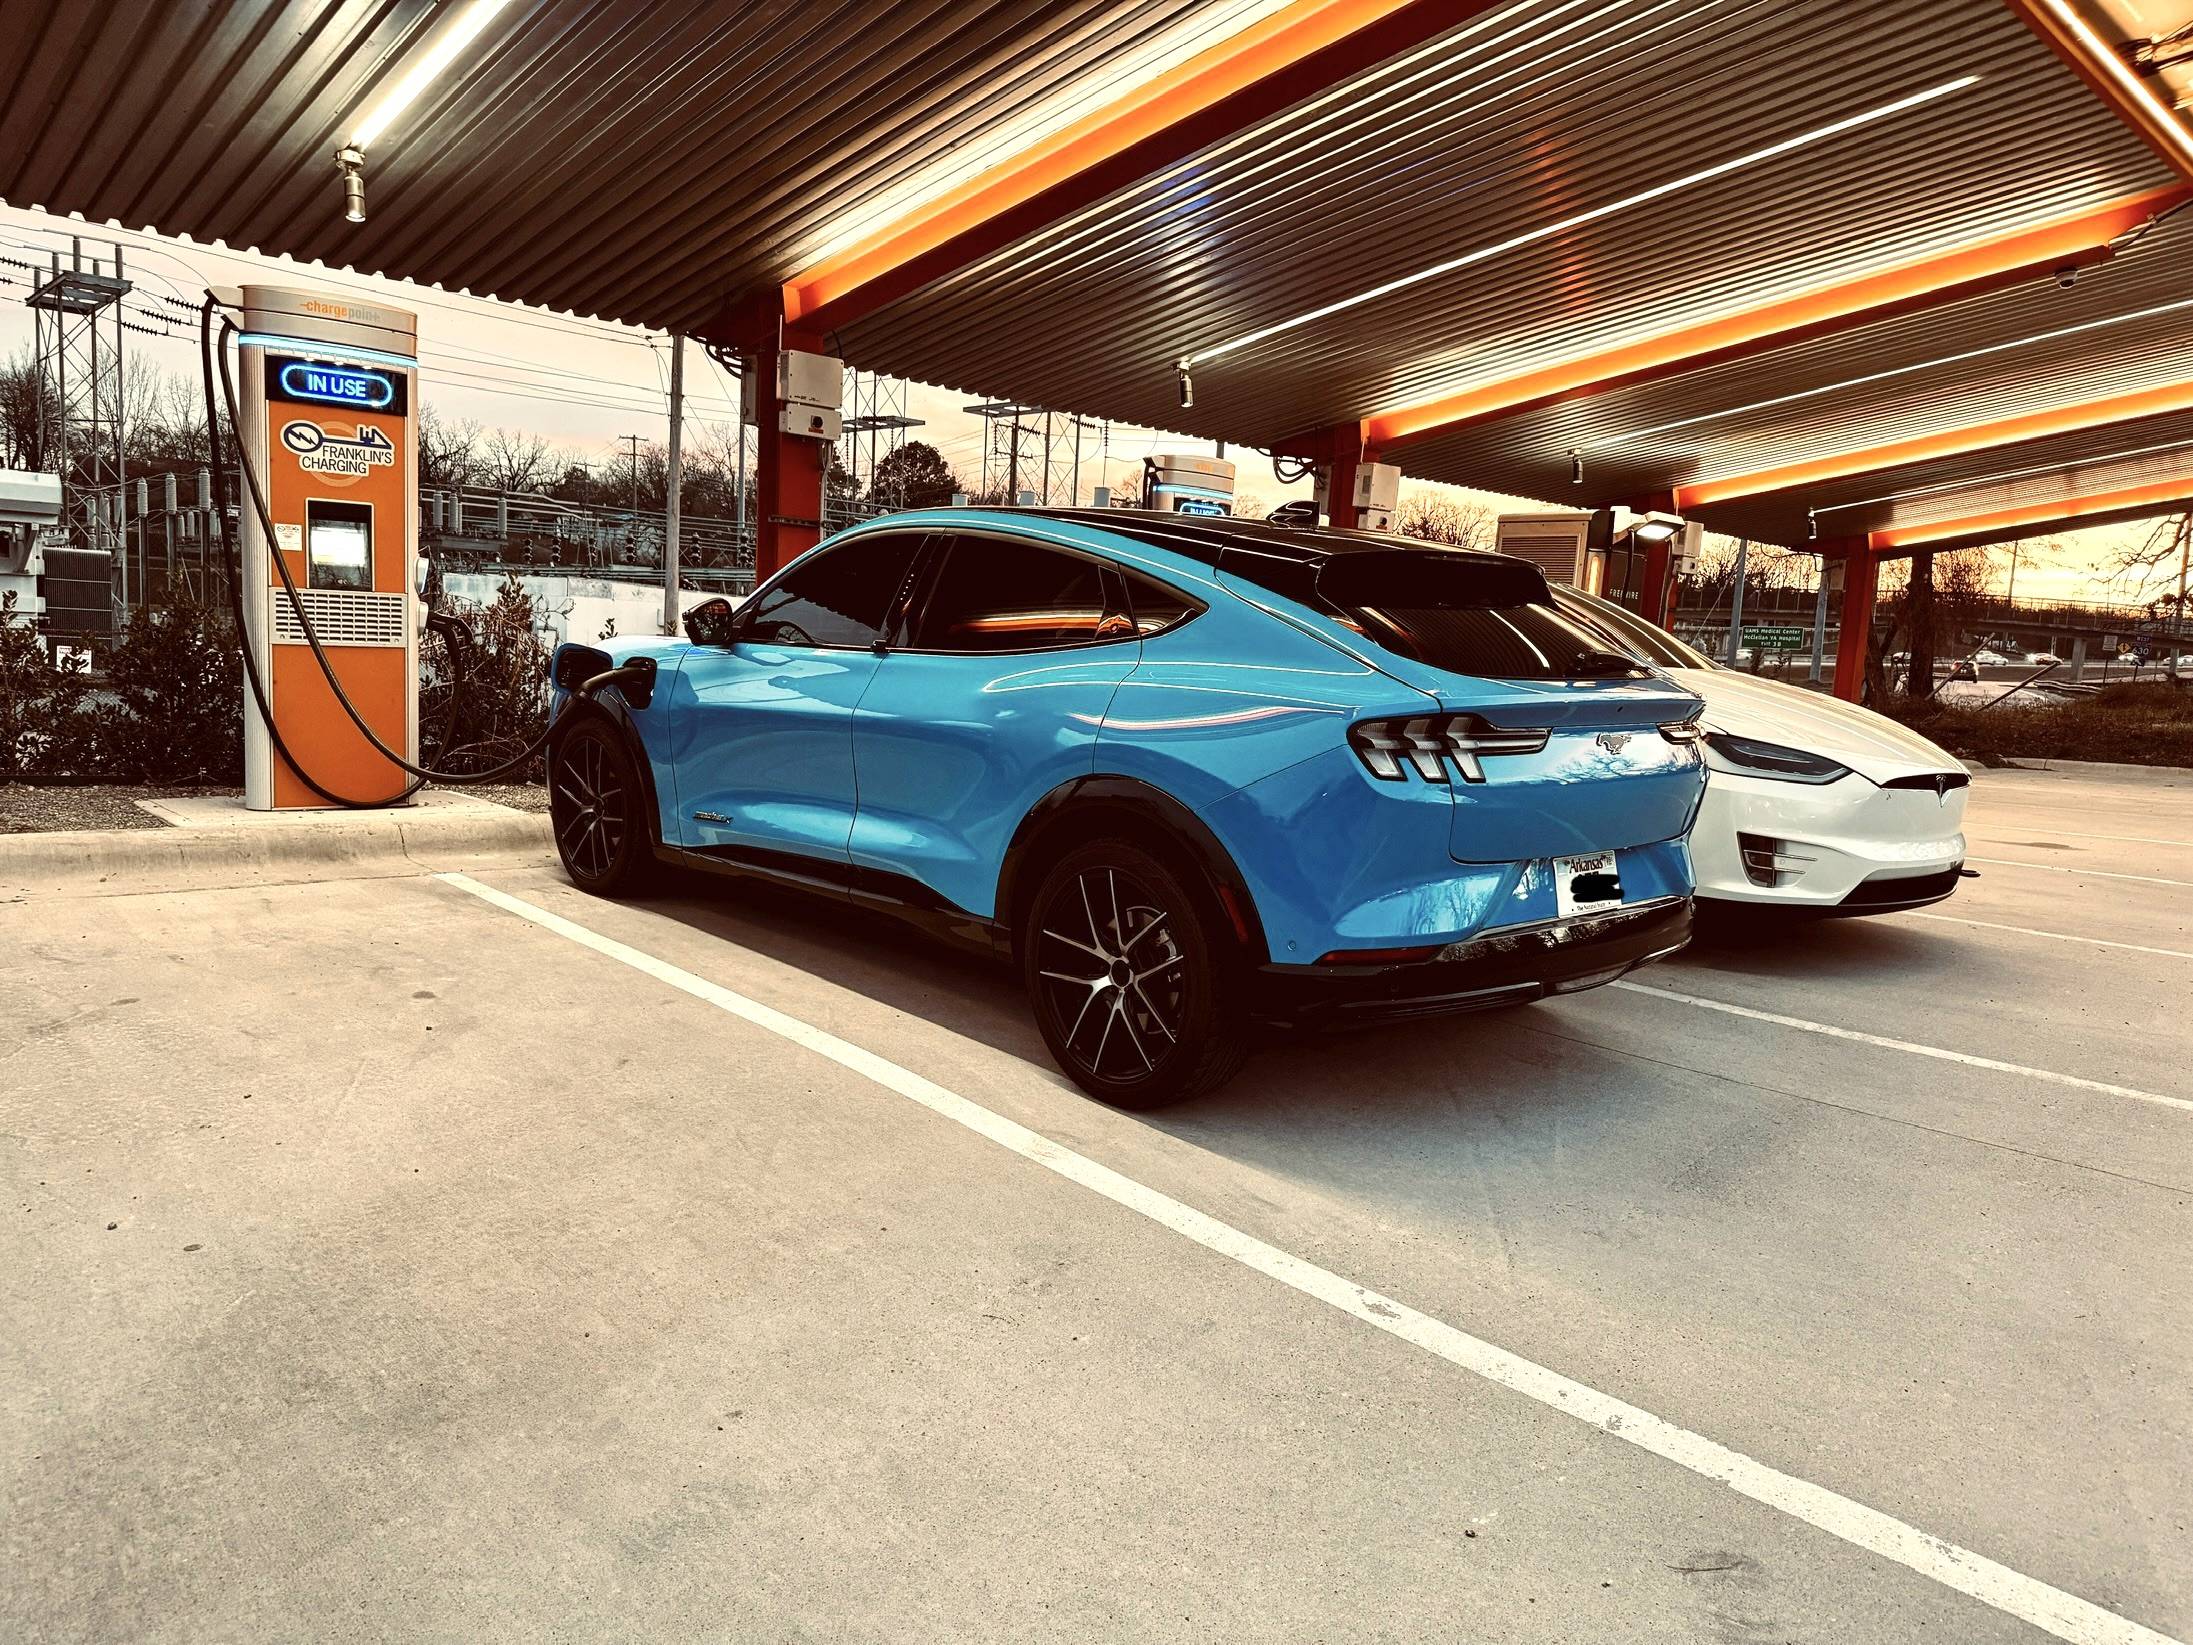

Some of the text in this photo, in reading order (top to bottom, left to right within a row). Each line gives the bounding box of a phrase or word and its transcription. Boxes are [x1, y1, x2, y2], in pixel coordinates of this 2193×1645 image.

[308, 373, 366, 397] IN USE
[322, 445, 392, 464] FRANKLIN'S
[301, 455, 367, 475] CHARGING
[1569, 857, 1604, 873] Arkansas
